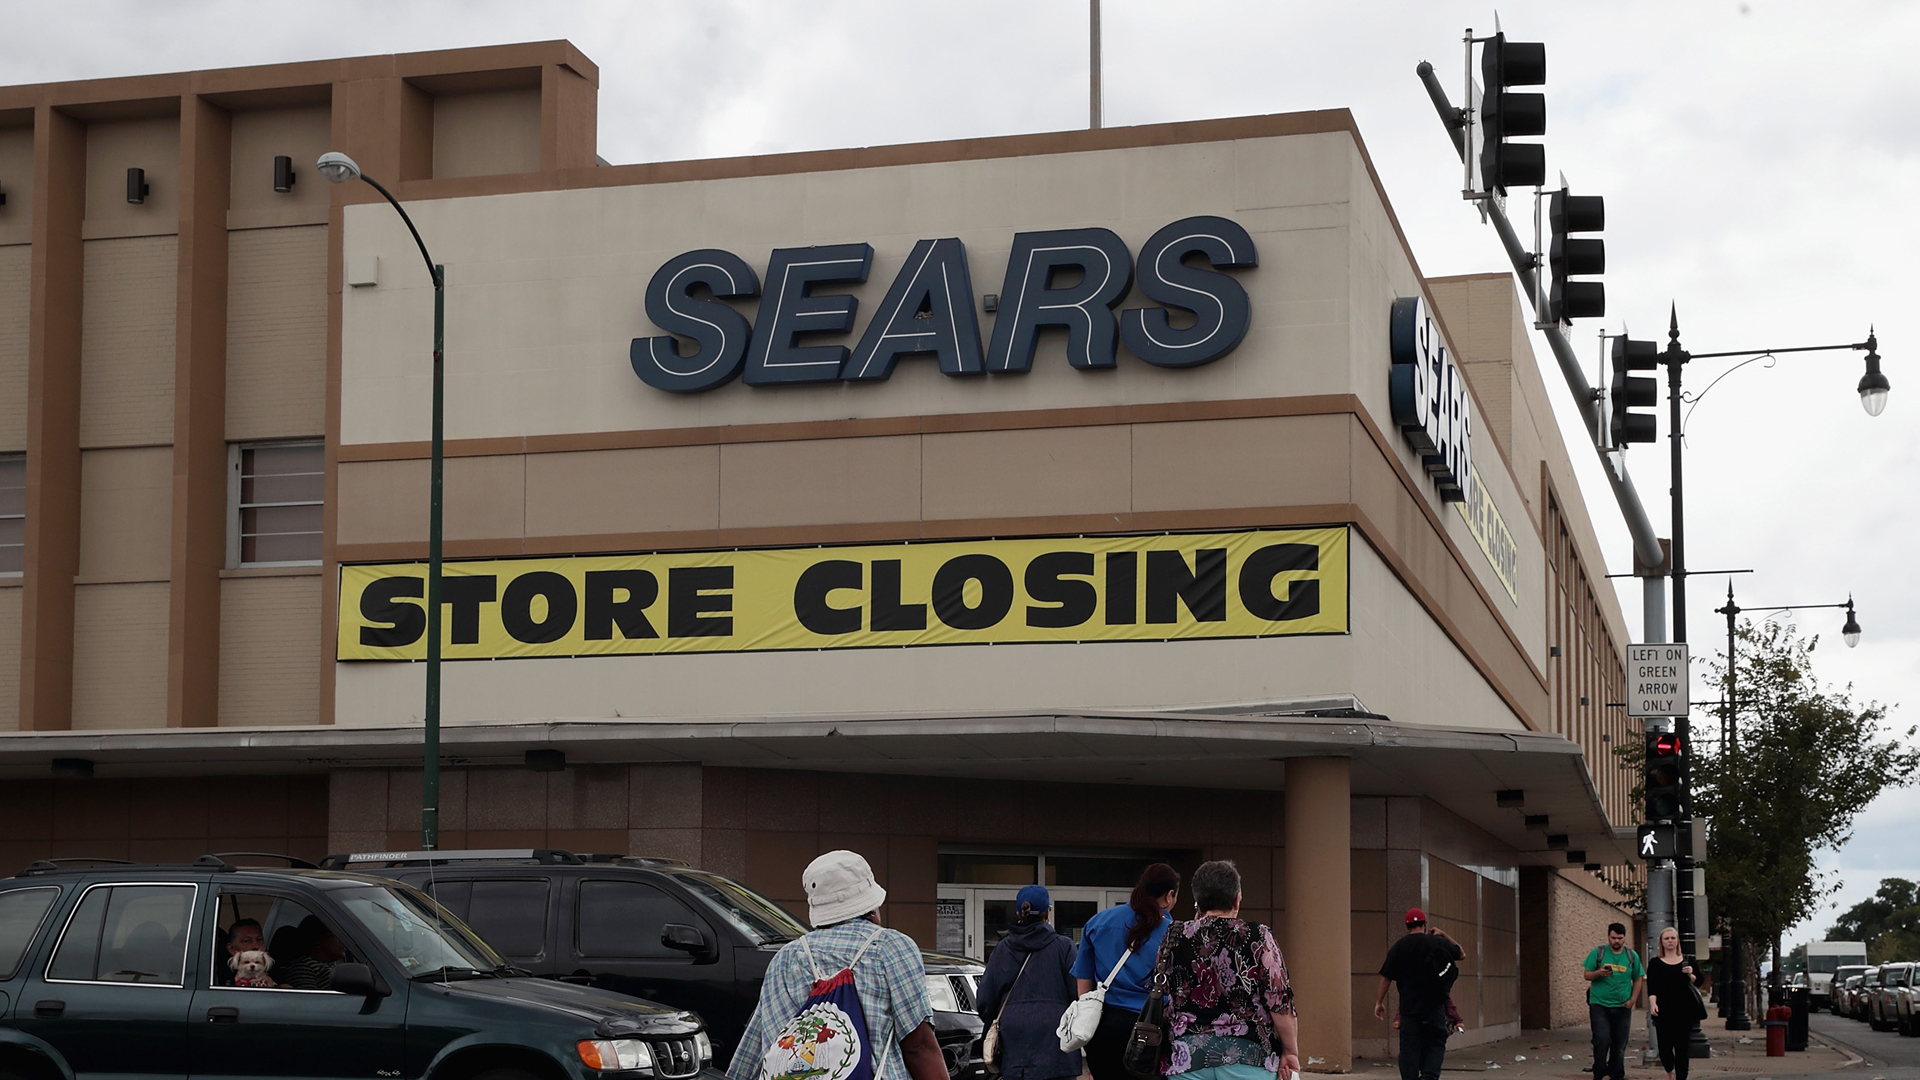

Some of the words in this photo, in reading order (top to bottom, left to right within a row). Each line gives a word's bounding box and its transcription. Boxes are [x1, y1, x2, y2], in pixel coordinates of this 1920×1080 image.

[630, 215, 1259, 394] SEARS
[1413, 296, 1472, 503] SEARS
[1463, 474, 1484, 541] ORE
[1487, 503, 1517, 595] CLOSING
[359, 565, 734, 648] STORE
[794, 543, 1321, 633] CLOSING
[1633, 649, 1660, 661] LEFT
[1666, 649, 1682, 661] ON
[1639, 666, 1677, 678] GREEN
[1638, 682, 1678, 695] ARROW
[1643, 700, 1673, 712] ONLY
[350, 852, 408, 861] PATHFINDER
